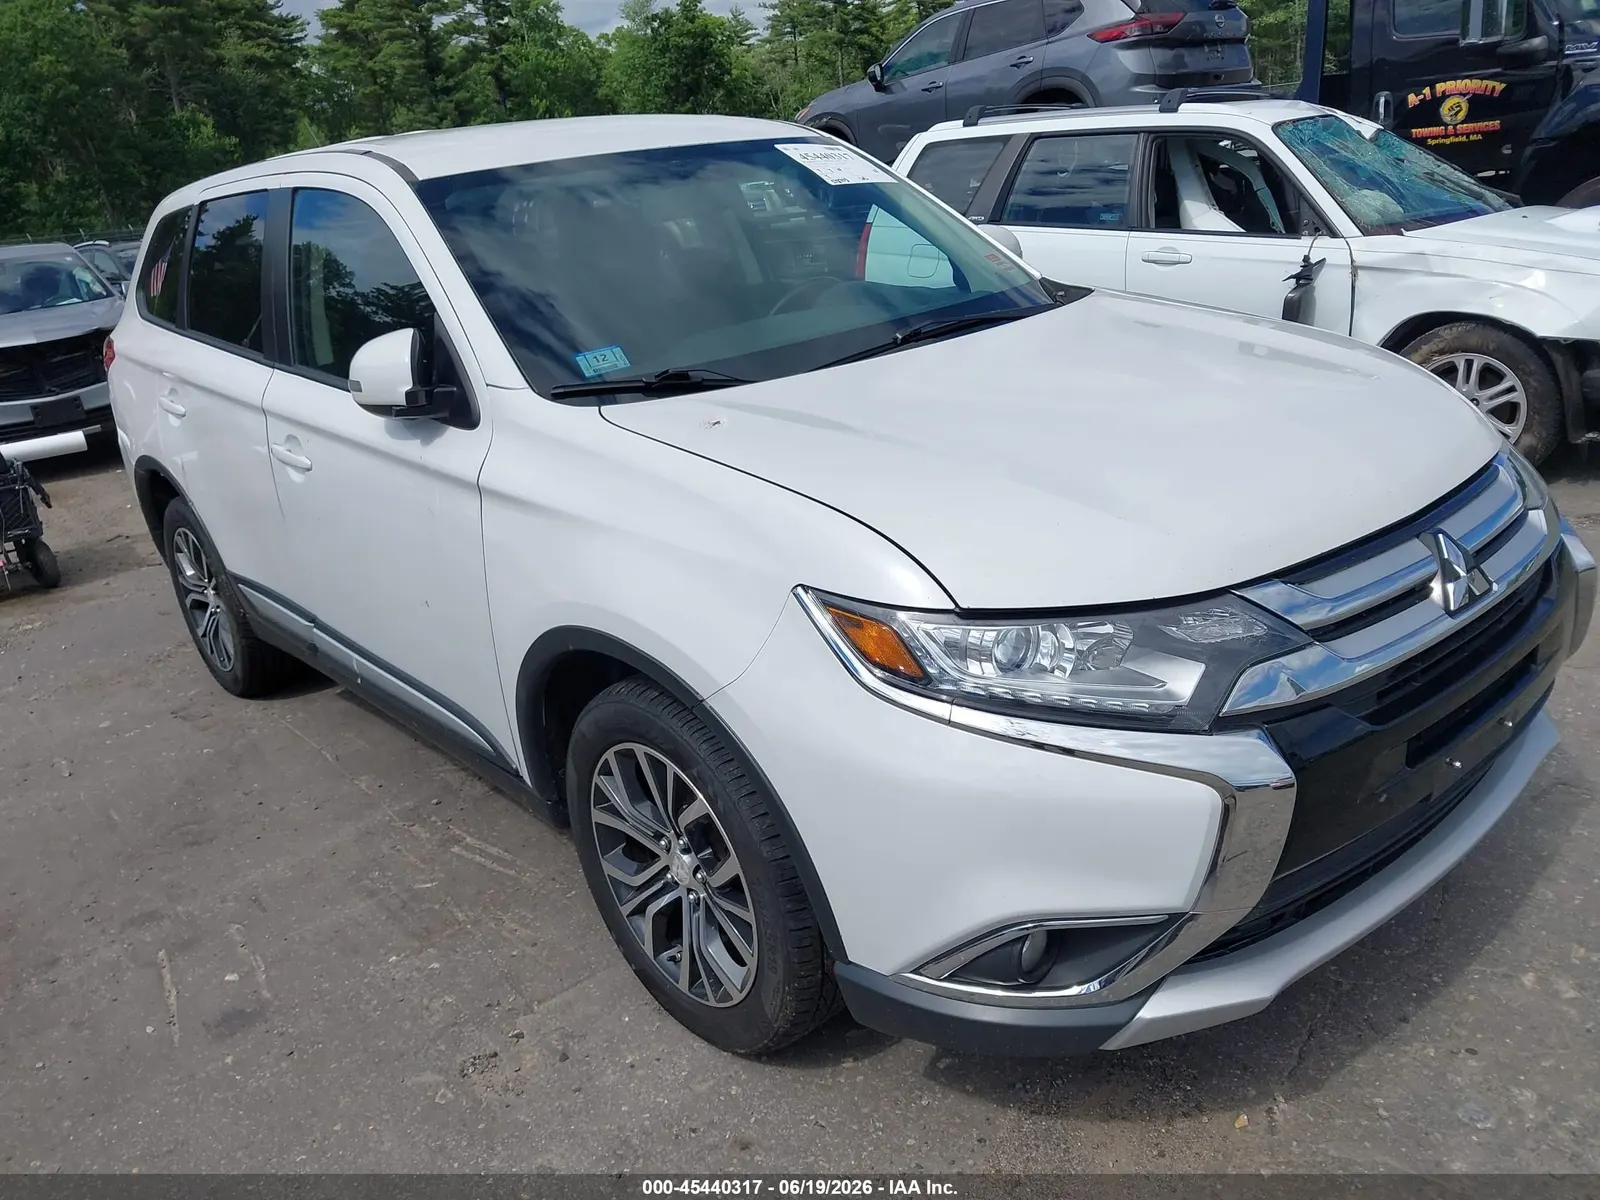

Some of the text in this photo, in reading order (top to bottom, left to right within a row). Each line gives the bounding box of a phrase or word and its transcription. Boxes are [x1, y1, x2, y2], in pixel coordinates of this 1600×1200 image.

[1407, 79, 1507, 108] A-1 PRIORITY
[1411, 120, 1501, 138] TOWING & SERVICES
[1427, 133, 1483, 146] Springfield, MA
[592, 354, 609, 364] 12
